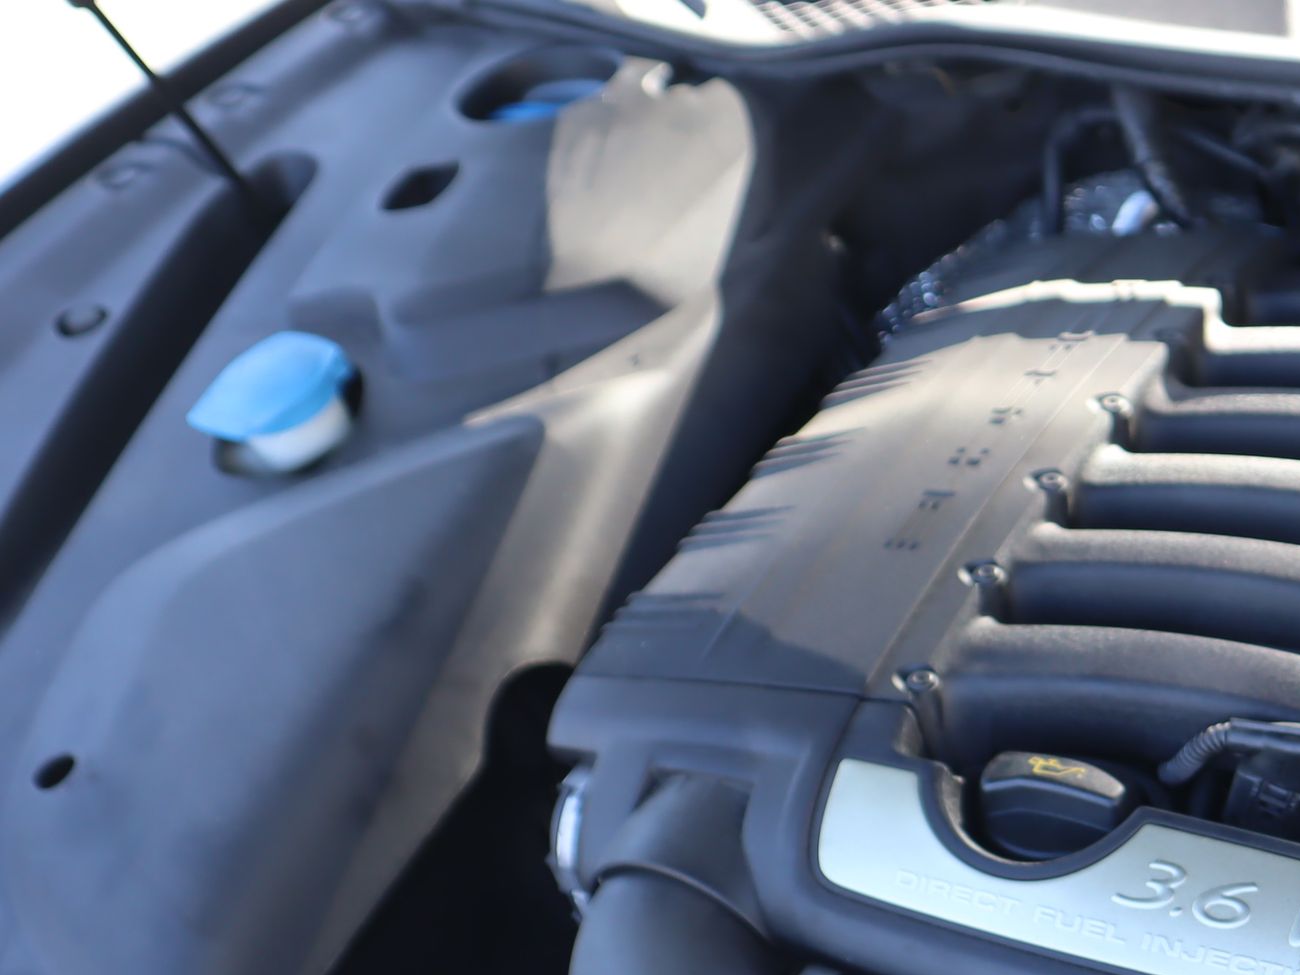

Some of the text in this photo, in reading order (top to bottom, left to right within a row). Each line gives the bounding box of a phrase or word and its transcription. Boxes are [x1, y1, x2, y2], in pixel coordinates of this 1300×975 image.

[894, 869, 1021, 916] DIRECT
[1032, 903, 1127, 946] FUEL
[1110, 858, 1259, 930] 3.6
